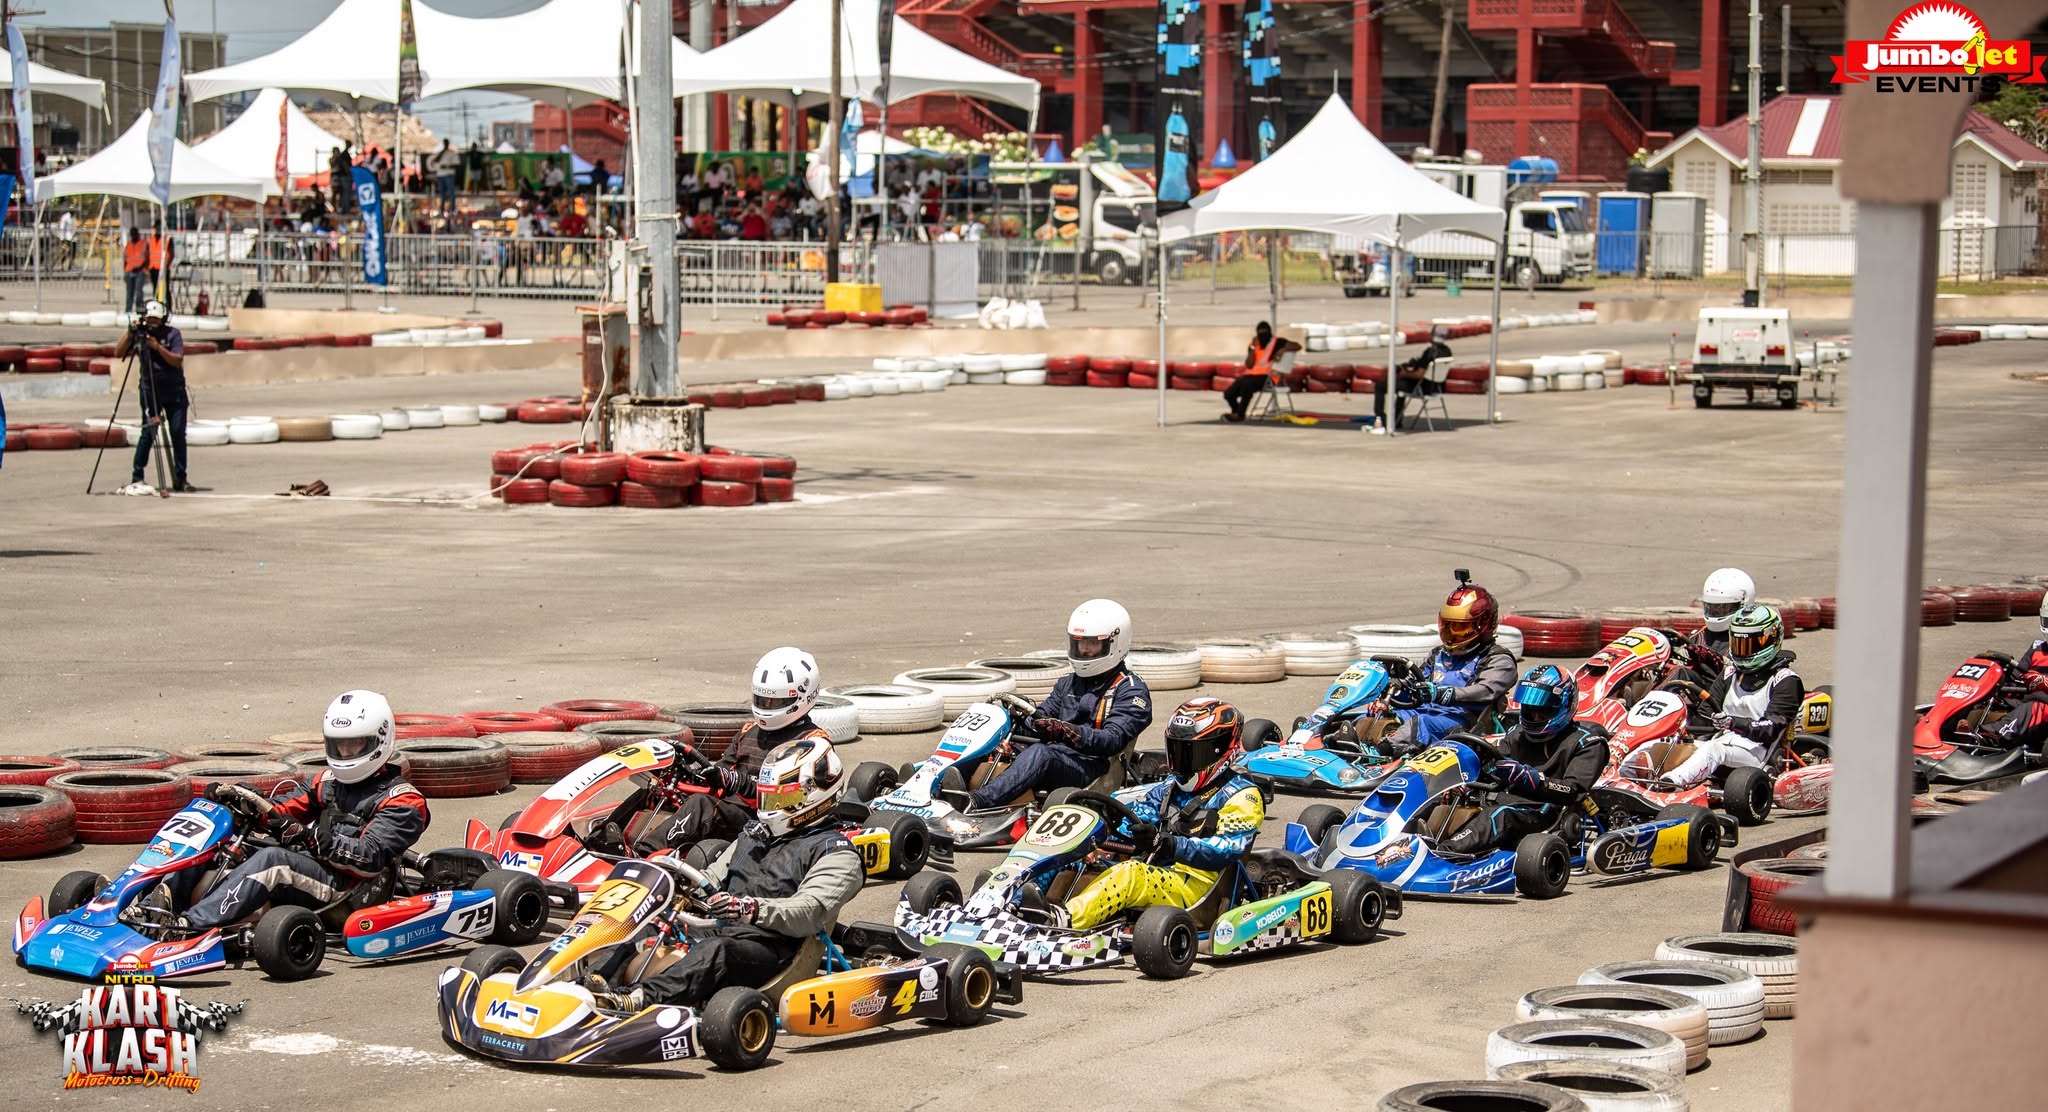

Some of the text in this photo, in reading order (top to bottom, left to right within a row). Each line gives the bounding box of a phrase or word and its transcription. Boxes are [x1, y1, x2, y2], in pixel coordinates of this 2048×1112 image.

[1956, 665, 1988, 679] 321
[1635, 701, 1668, 718] 15
[1810, 705, 1828, 722] 320
[163, 818, 207, 839] 79
[1036, 811, 1081, 838] 68
[1605, 841, 1648, 872] Praga
[588, 882, 642, 912] 4
[458, 902, 494, 934] 79
[1256, 905, 1287, 930] KOBELCO
[1307, 897, 1328, 932] 68
[62, 924, 104, 940] JEWELZ
[406, 924, 436, 944] JEWELZ
[891, 979, 918, 1016] 4
[482, 1035, 526, 1052] TERRACRETE
